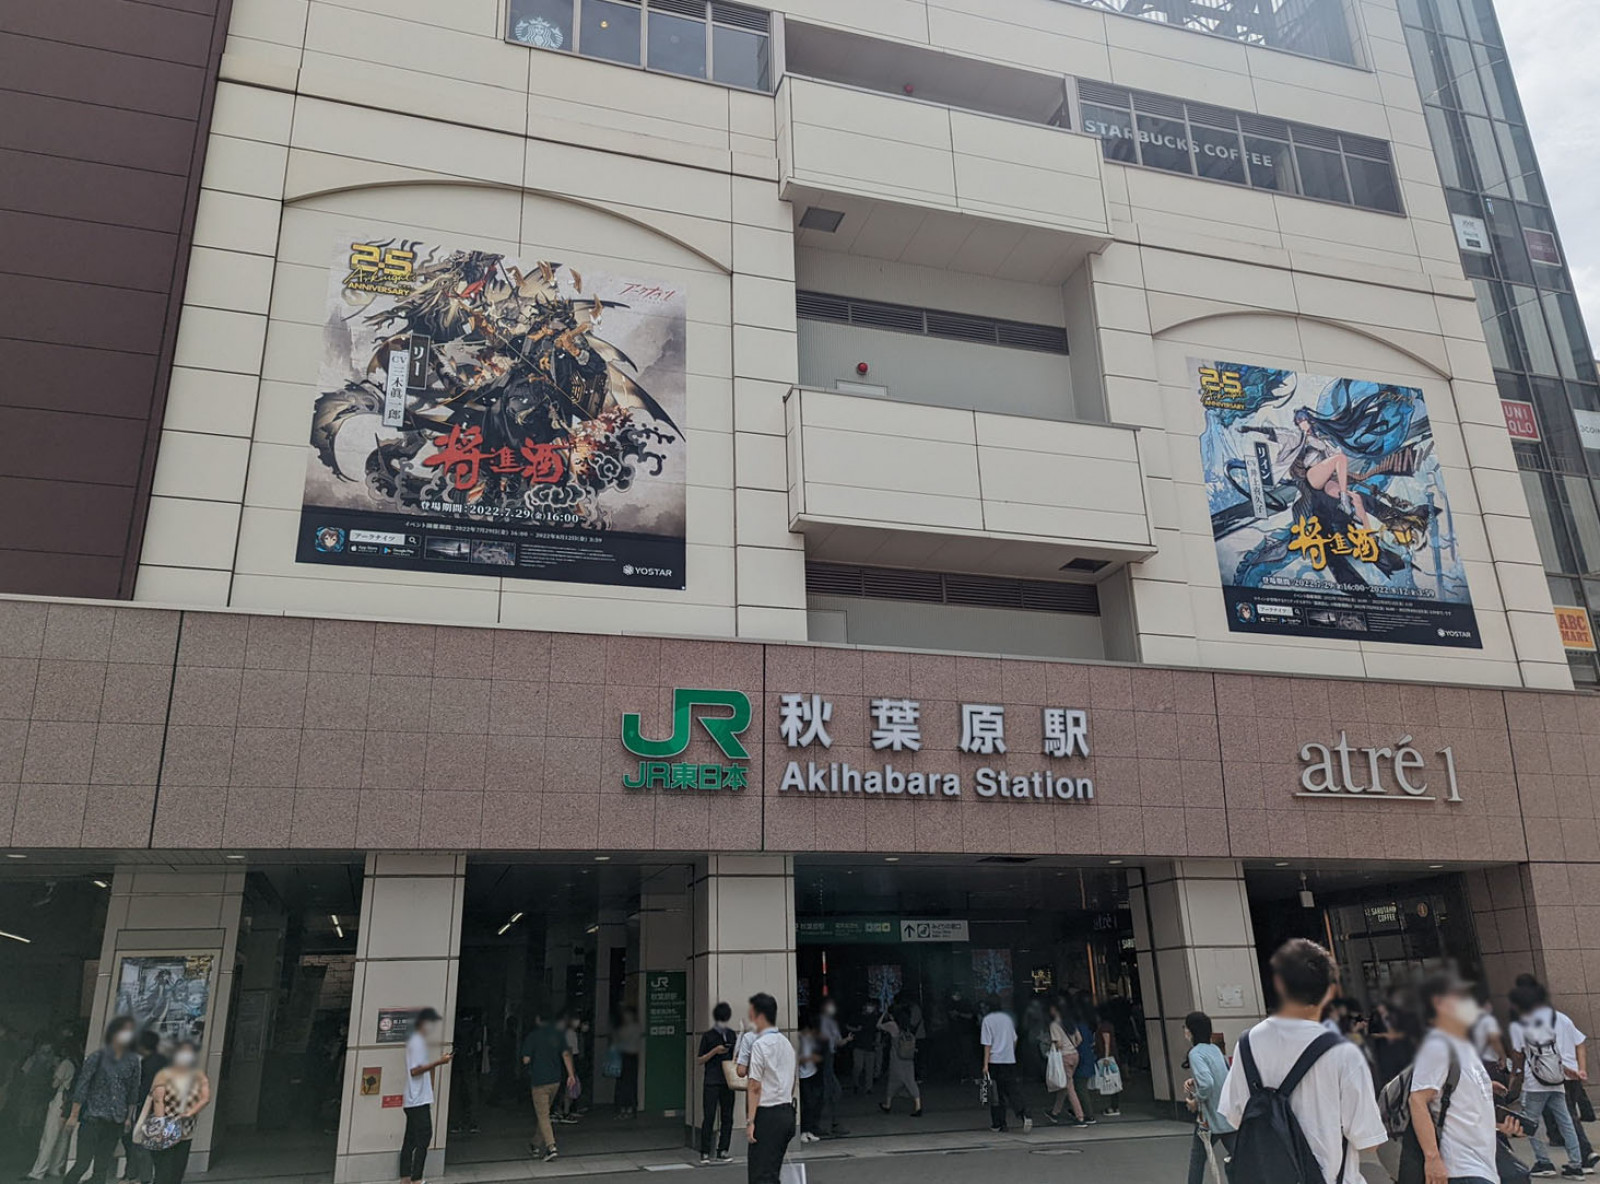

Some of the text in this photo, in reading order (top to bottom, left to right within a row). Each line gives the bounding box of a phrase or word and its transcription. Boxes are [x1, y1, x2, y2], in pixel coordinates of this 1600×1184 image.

[1085, 120, 1273, 167] STARBUCKS COFEE
[348, 282, 411, 296] ANNIVERSARY
[1504, 405, 1529, 420] UNI
[1507, 420, 1533, 434] QLO
[635, 566, 673, 577] YOSTAR
[1559, 614, 1587, 631] ABC
[1560, 630, 1590, 642] MART
[622, 688, 752, 759] JR
[780, 693, 1090, 759] 秋葉原駅
[1299, 730, 1429, 796] atré
[623, 761, 748, 790] JR東日本
[779, 760, 1095, 800] Akihabara Station
[651, 976, 669, 988] JR
